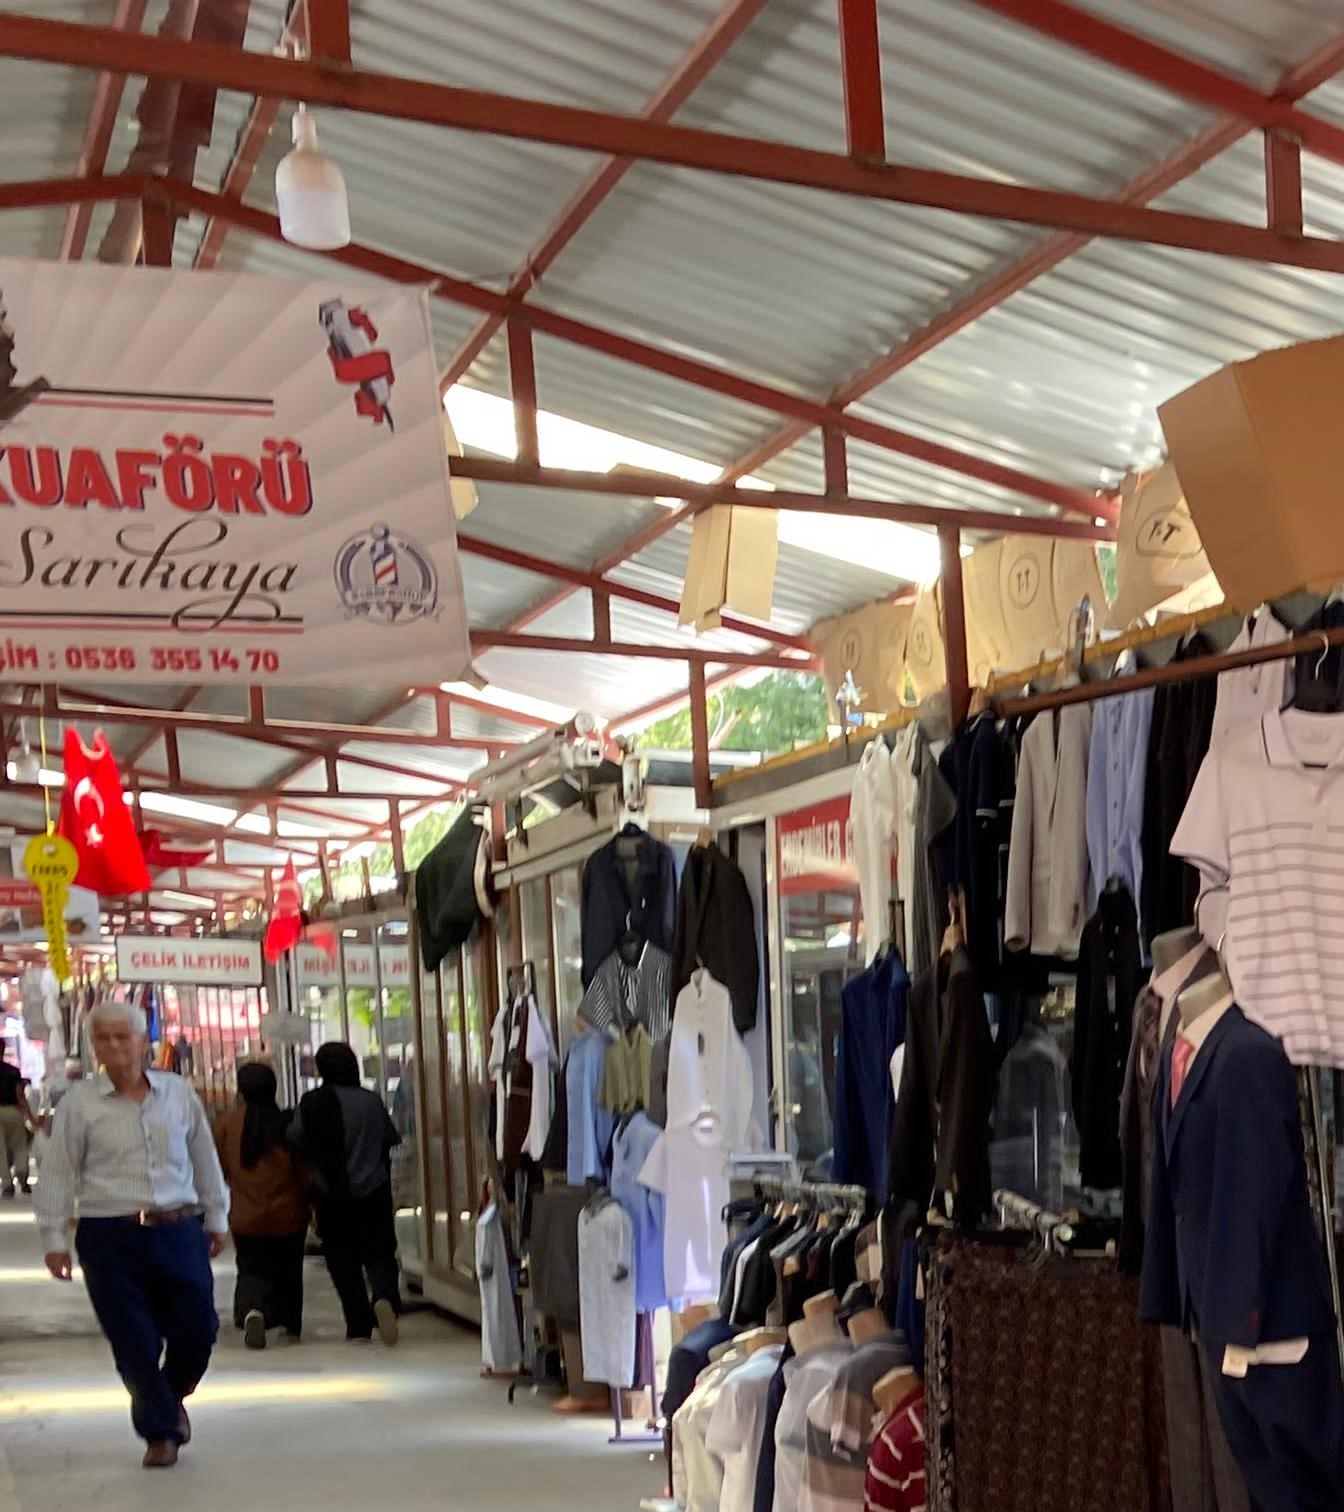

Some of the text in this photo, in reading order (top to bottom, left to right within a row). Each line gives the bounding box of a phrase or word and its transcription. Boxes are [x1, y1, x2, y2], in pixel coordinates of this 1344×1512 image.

[209, 647, 239, 671] 14
[246, 650, 279, 672] 70
[131, 950, 250, 972] ÇELİK İLETİŞİM
